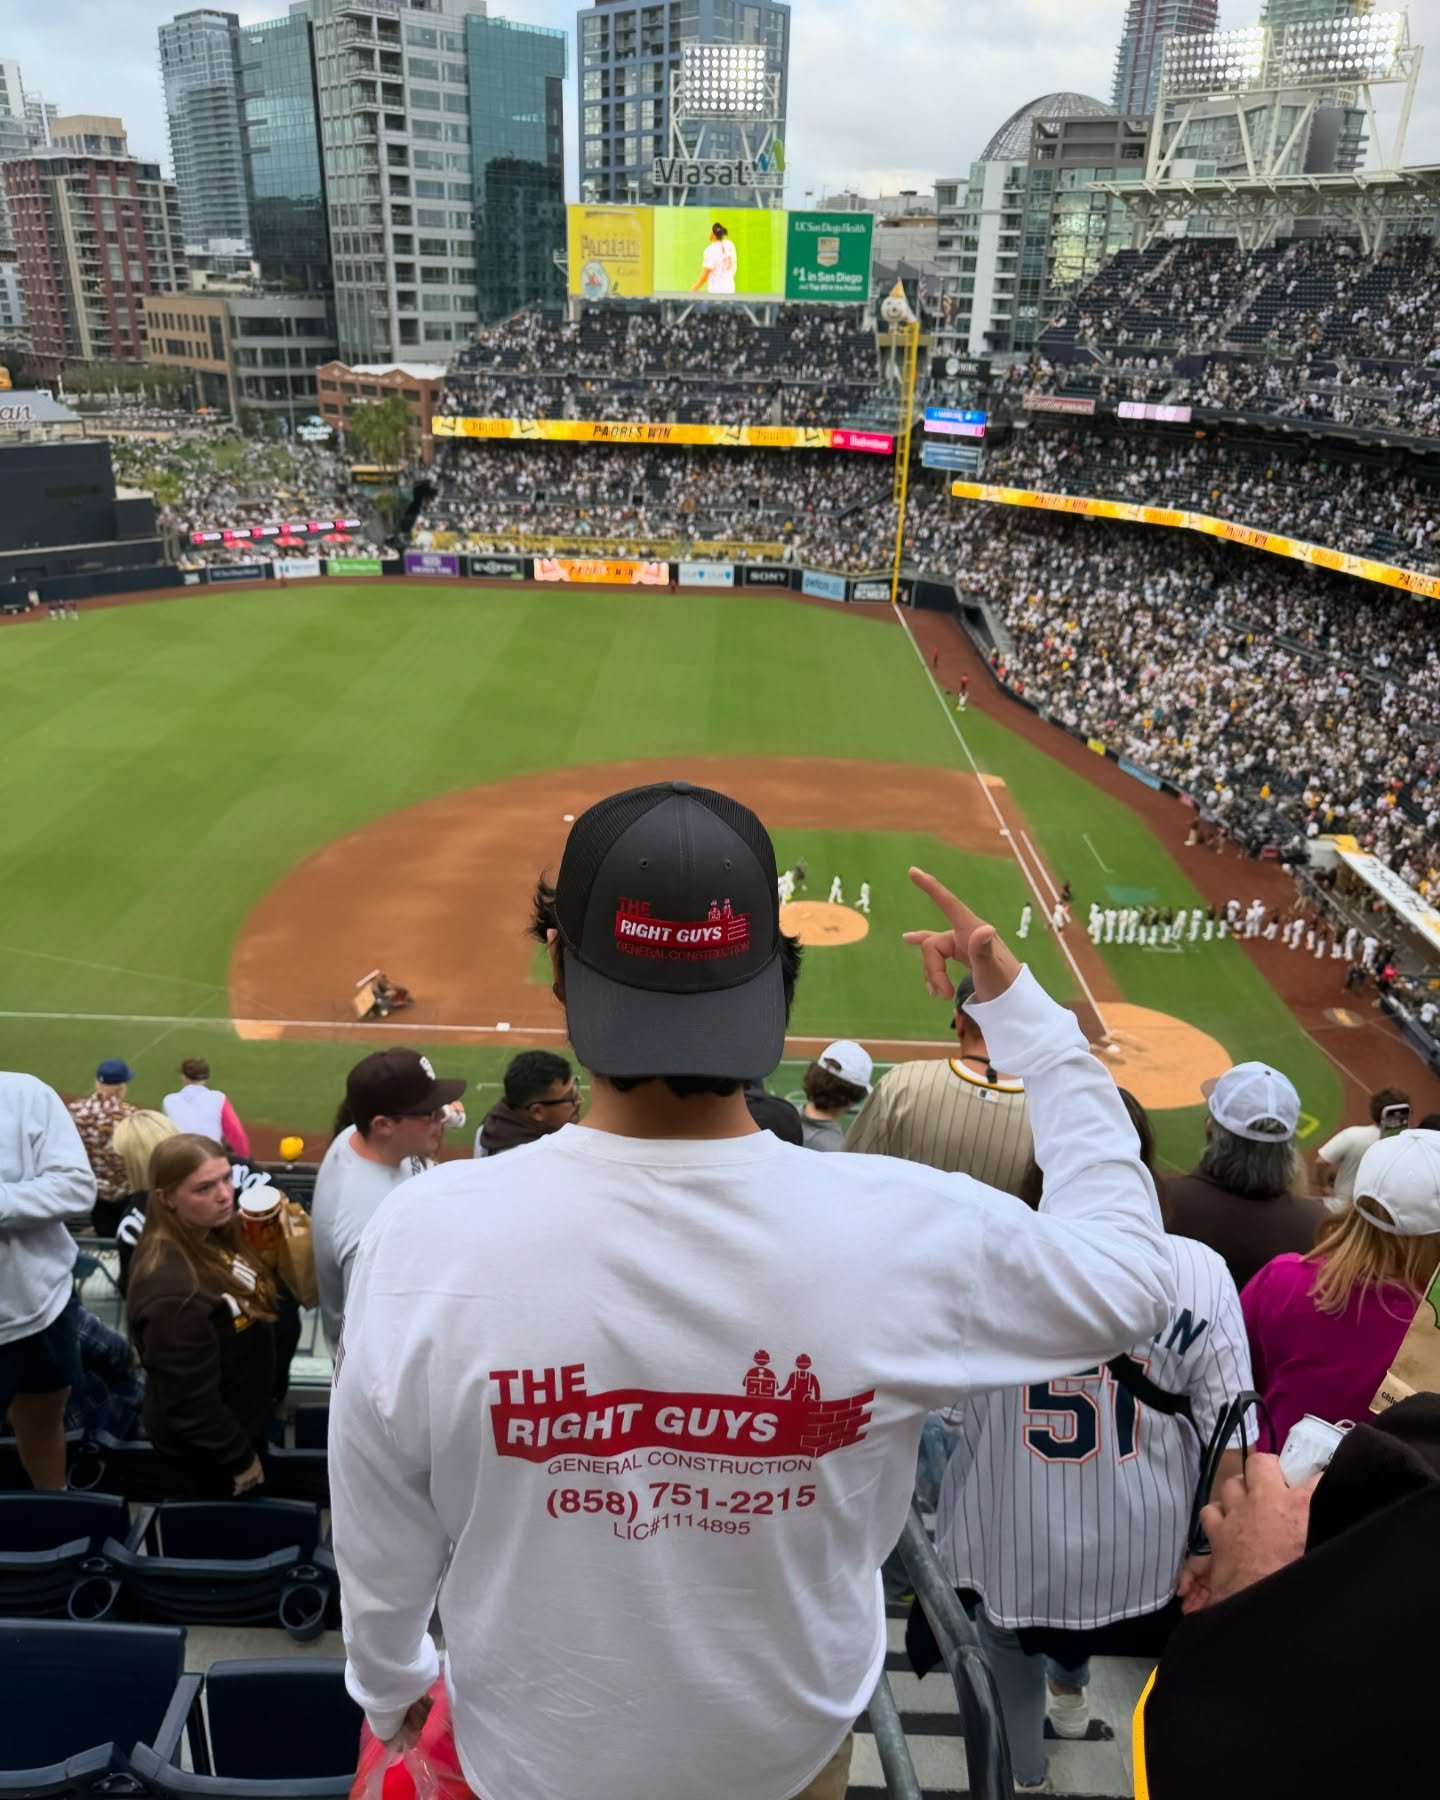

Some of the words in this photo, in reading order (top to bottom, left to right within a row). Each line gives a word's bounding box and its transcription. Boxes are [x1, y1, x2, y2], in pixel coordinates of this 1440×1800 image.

[658, 159, 747, 186] Viasat
[808, 271, 817, 282] in
[818, 271, 835, 282] San
[836, 271, 863, 284] Diego
[593, 424, 644, 438] PADRES
[647, 426, 672, 439] WIN
[750, 571, 787, 582] SONY
[617, 896, 652, 915] THE
[620, 919, 672, 942] RIGHT
[676, 926, 722, 943] GUYS
[616, 941, 667, 960] GENERAL
[669, 942, 750, 961] CONSTRUCTION
[489, 1363, 587, 1405] THE
[507, 1403, 643, 1447] RIGHT
[655, 1406, 779, 1442] GUYS
[547, 1453, 643, 1475] GENERAL
[647, 1451, 812, 1475] CONSTRUCTION
[547, 1489, 639, 1523] (858)
[648, 1482, 816, 1516] 751-2215
[614, 1514, 751, 1541] LIC#1114895
